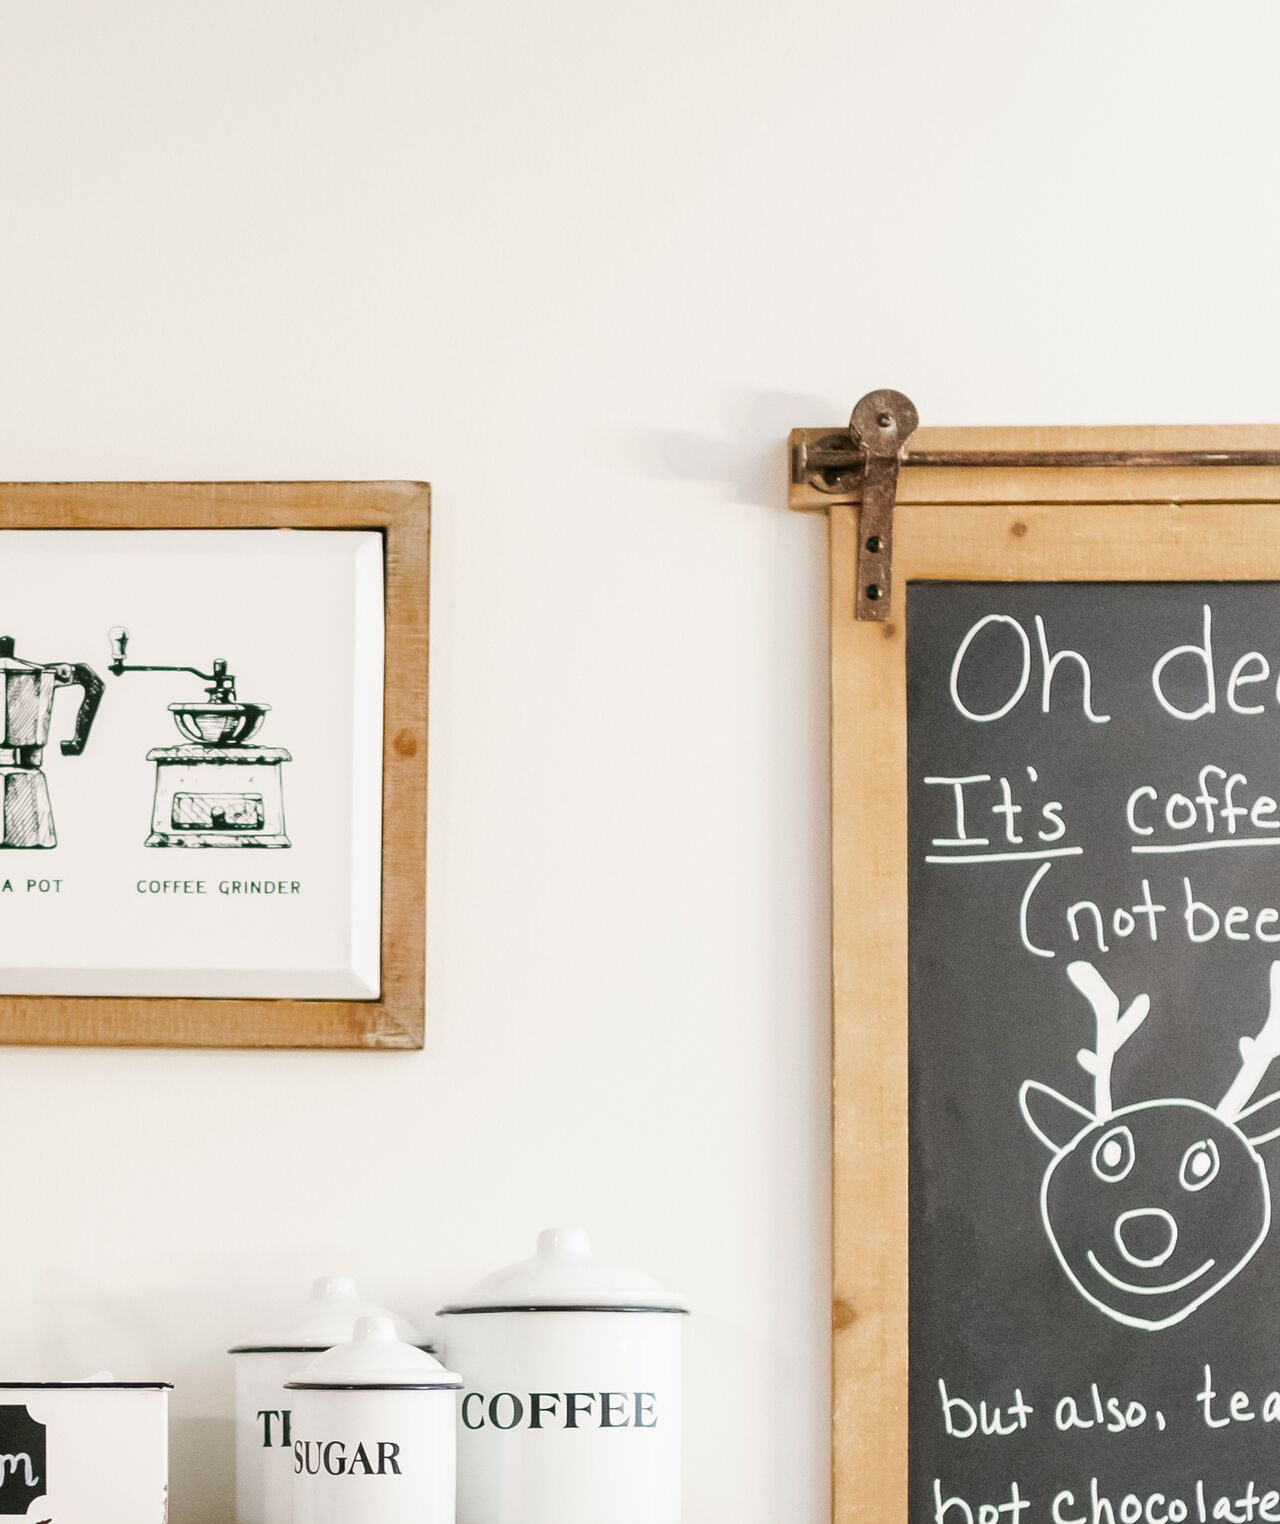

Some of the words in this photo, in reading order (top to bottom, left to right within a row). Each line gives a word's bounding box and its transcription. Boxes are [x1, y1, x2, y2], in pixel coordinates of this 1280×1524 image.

[949, 614, 1112, 724] Oh
[923, 765, 1066, 846] It's
[26, 879, 64, 893] POT
[136, 879, 207, 894] COFFEE
[218, 880, 301, 896] GRINDER
[1019, 861, 1167, 958] (not
[460, 1391, 658, 1431] COFFEE
[938, 1378, 1034, 1439] but
[1054, 1382, 1166, 1433] also,
[294, 1439, 402, 1476] SUGAR
